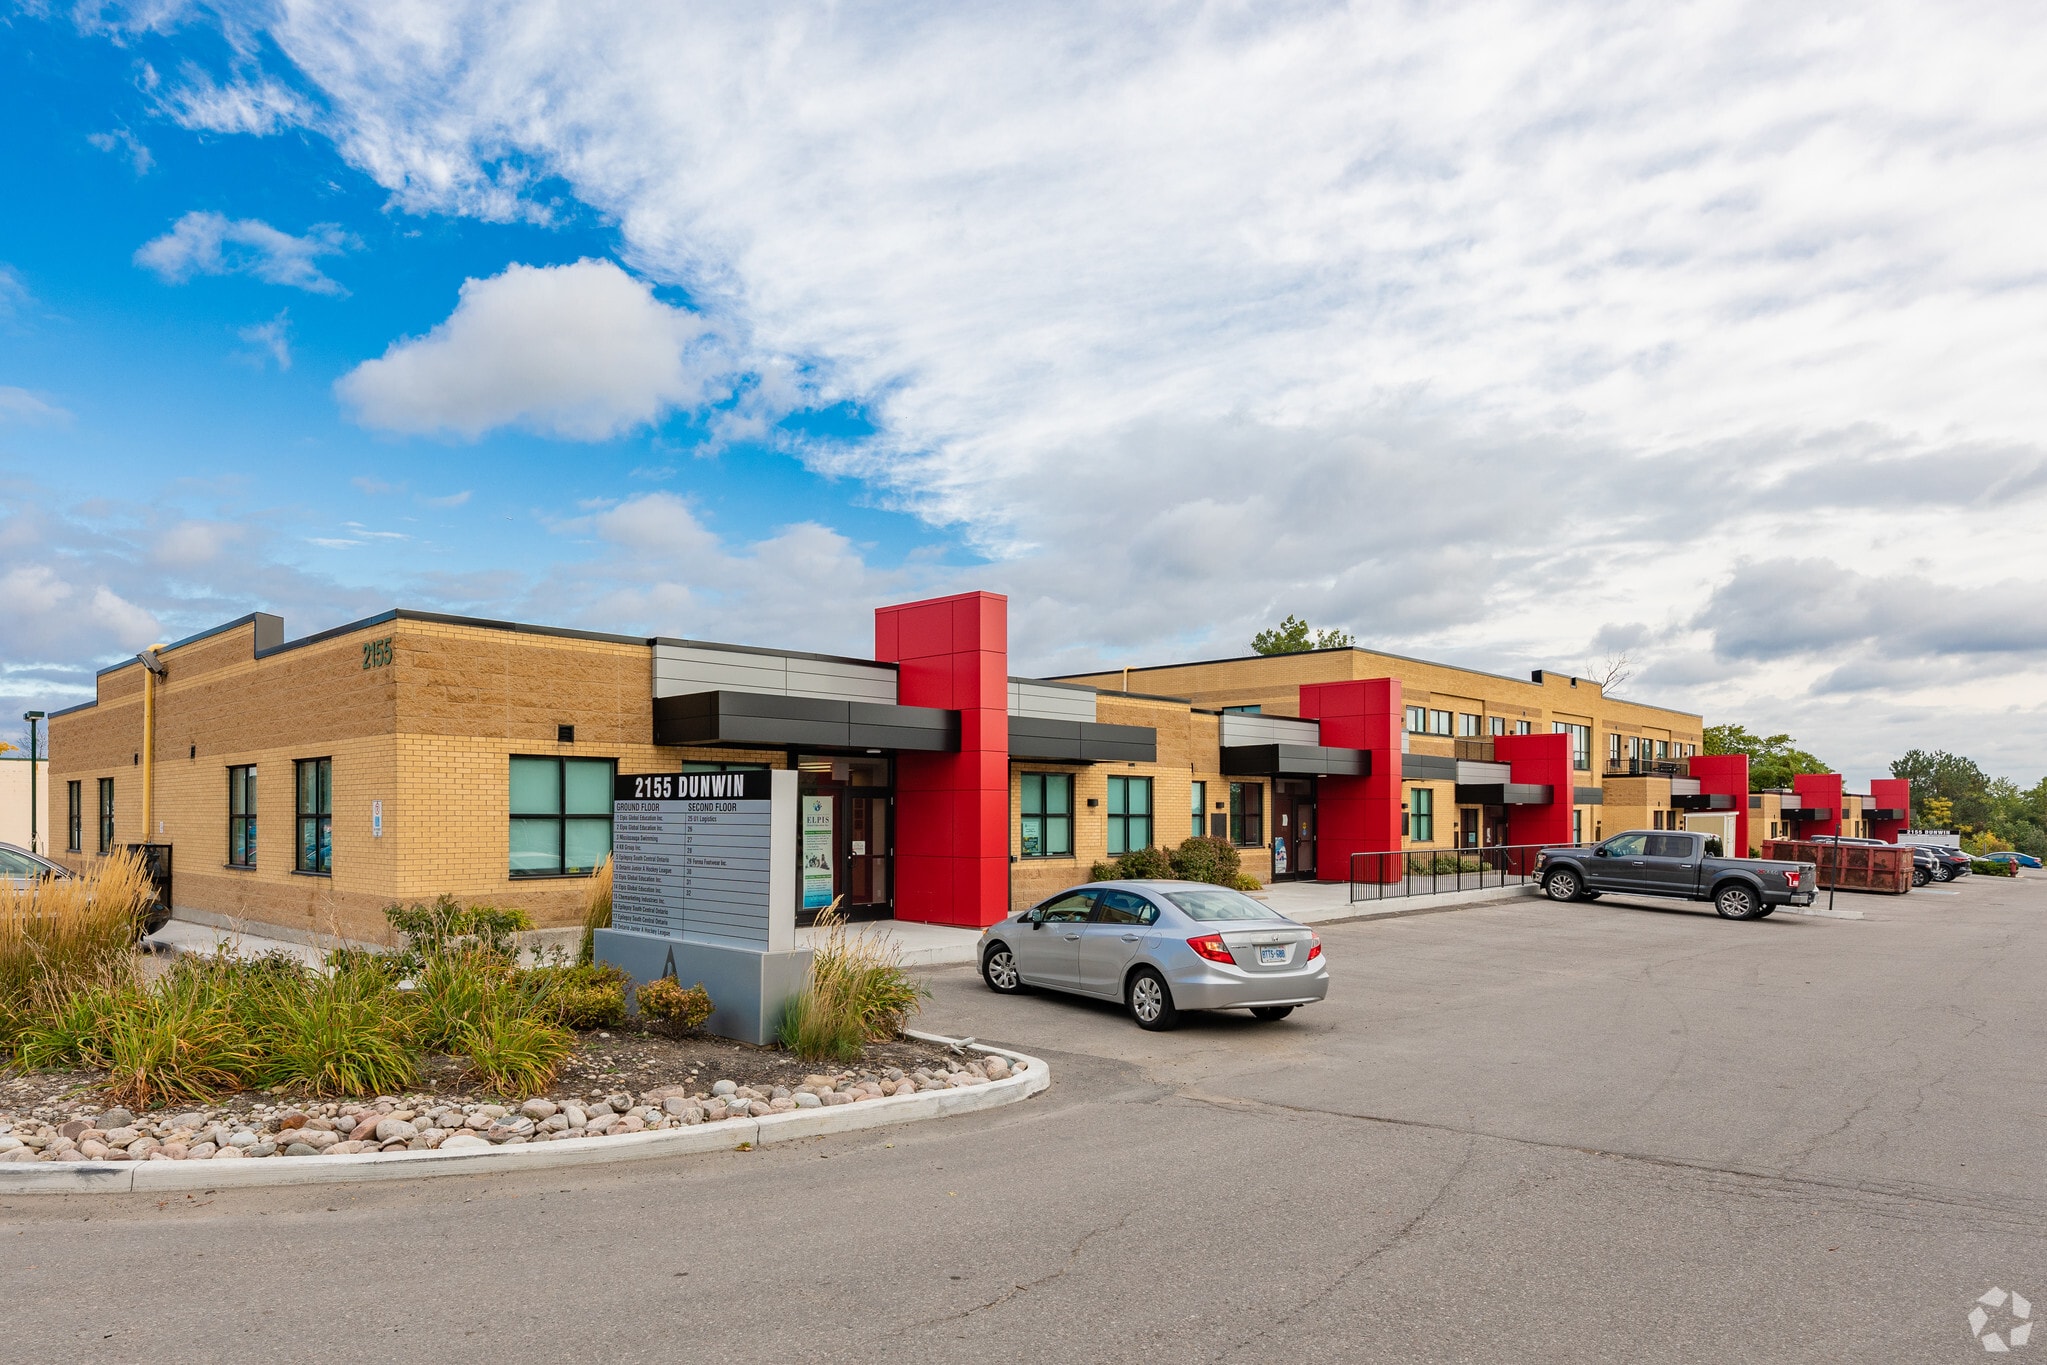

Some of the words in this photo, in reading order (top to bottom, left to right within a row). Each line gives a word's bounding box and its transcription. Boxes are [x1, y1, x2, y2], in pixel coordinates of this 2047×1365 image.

[362, 637, 393, 670] 2155
[634, 776, 672, 798] 2155
[678, 774, 745, 798] DUNWIN
[616, 802, 640, 812] GROUND
[641, 802, 660, 812] FLOOR
[687, 802, 714, 812] SECOND
[715, 802, 737, 812] FLOOR
[700, 815, 717, 823] Logistics
[806, 816, 830, 824] ELPIS
[640, 834, 658, 842] Swimming
[658, 928, 670, 937] League
